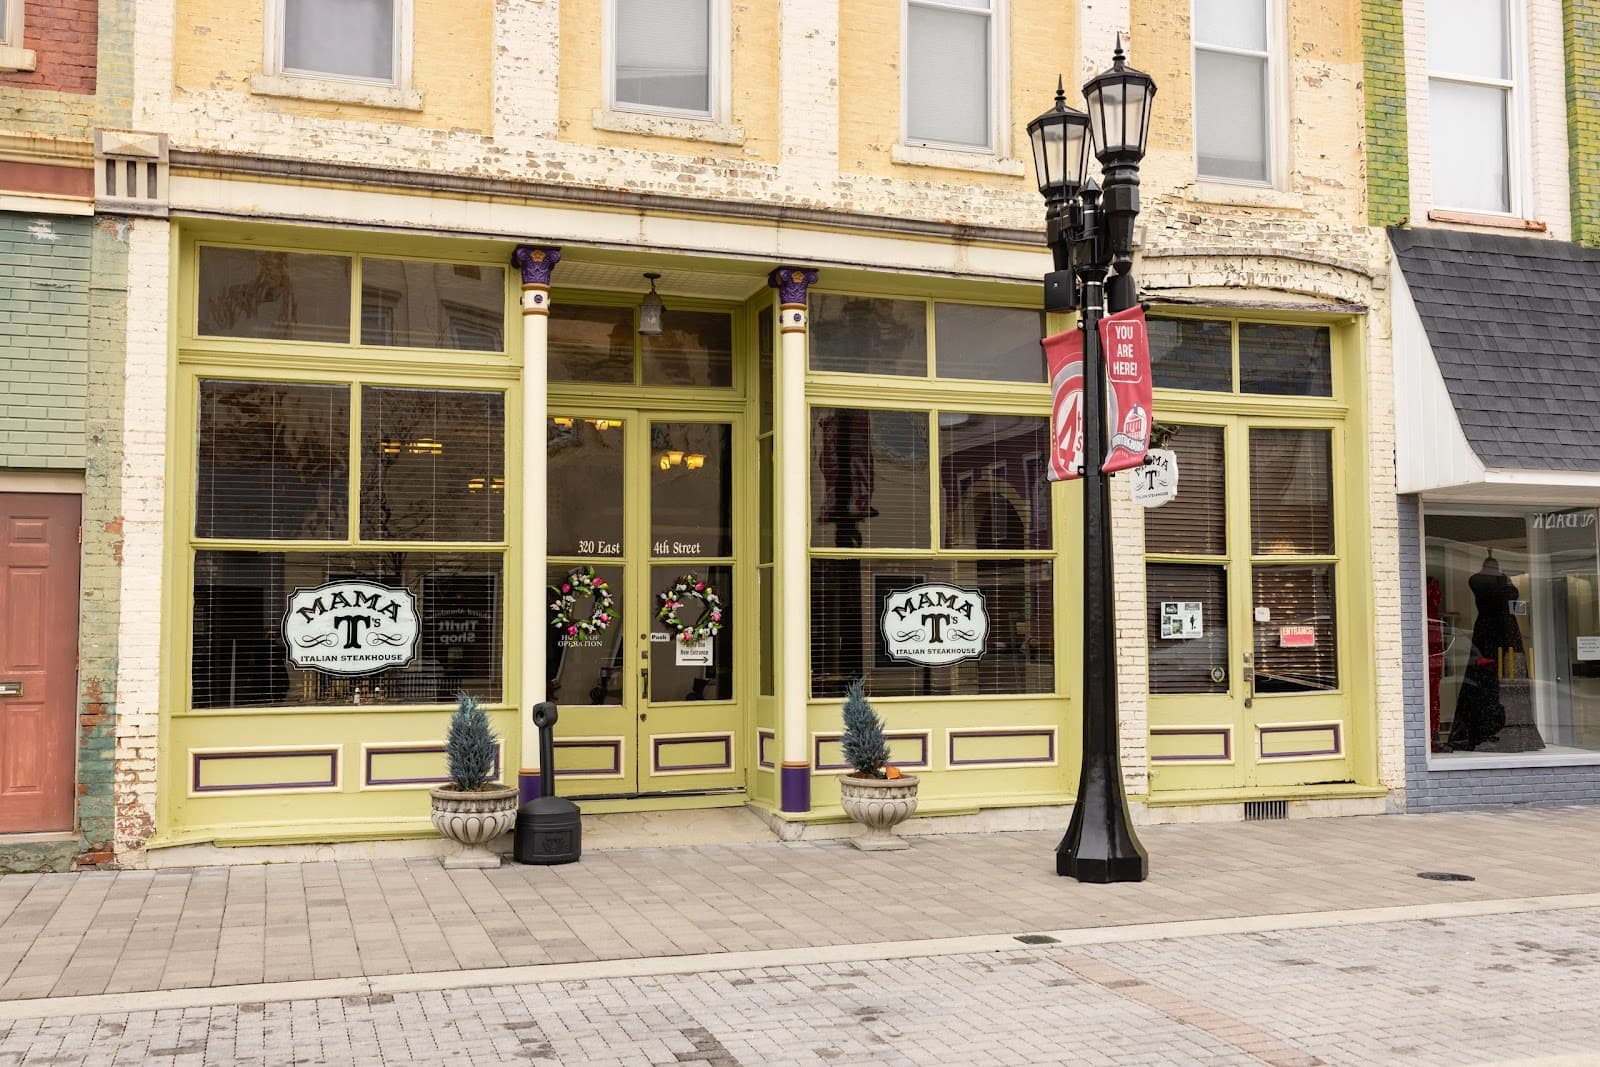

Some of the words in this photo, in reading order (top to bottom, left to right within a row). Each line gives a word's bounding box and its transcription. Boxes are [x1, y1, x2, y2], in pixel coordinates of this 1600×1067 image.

[1115, 325, 1134, 340] YOU
[1116, 343, 1134, 358] ARE
[1113, 361, 1138, 377] HERE!
[577, 540, 594, 554] 320
[597, 541, 620, 554] East
[653, 540, 670, 554] 4th
[672, 541, 701, 554] Street
[296, 590, 402, 624] MAMA
[891, 591, 974, 621] MAMA
[300, 654, 338, 662] ITALIAN
[340, 653, 403, 662] STEAKHOUSE
[927, 647, 976, 655] STEAKHOUSE
